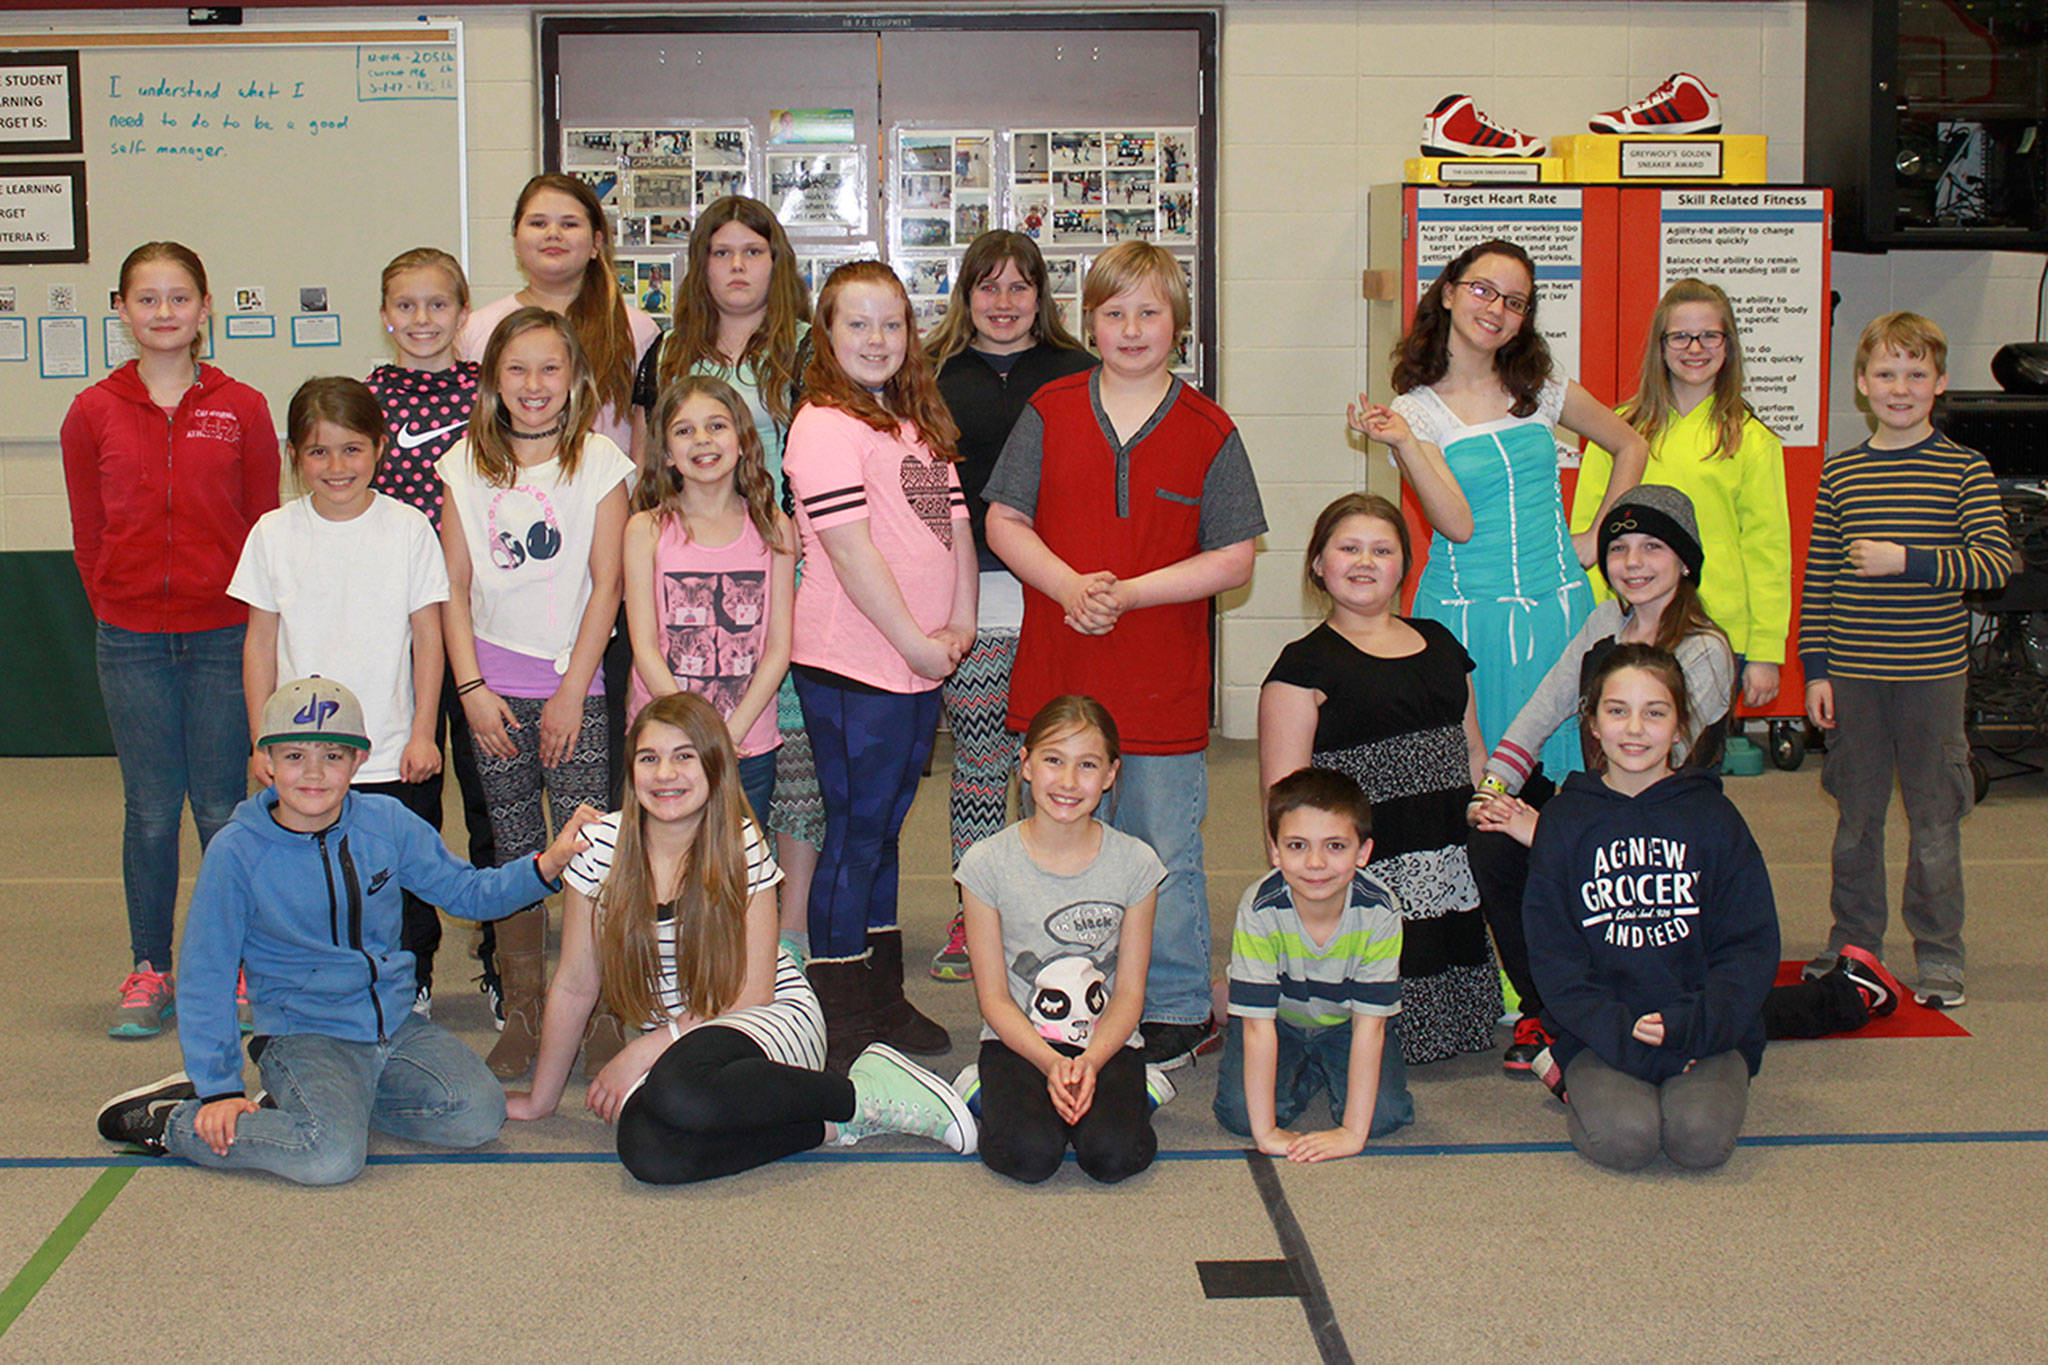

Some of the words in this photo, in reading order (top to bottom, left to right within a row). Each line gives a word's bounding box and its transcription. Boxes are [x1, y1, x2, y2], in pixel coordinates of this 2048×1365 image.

[5, 74, 63, 87] STUDENT
[109, 75, 122, 98] I
[138, 77, 221, 99] understand
[238, 80, 280, 98] what
[292, 82, 304, 98] I
[0, 95, 43, 108] RNING
[32, 116, 48, 129] IS:
[109, 112, 144, 128] need
[161, 112, 177, 127] to
[191, 113, 210, 128] do
[222, 114, 240, 129] to
[254, 115, 274, 130] be
[286, 121, 295, 130] a
[309, 115, 349, 136] good
[110, 139, 146, 155] self
[156, 145, 228, 161] manager.
[1680, 150, 1712, 158] GOLDEN
[6, 183, 63, 194] LEARNING
[1443, 193, 1484, 206] Target
[1489, 193, 1524, 204] Heart
[1528, 193, 1557, 204] Rate
[1678, 194, 1705, 205] Skill
[1710, 194, 1758, 205] Related
[1763, 194, 1807, 206] Fitness
[1458, 224, 1494, 233] slacking
[1497, 224, 1510, 232] off
[1526, 224, 1560, 233] working
[1563, 224, 1578, 232] too
[1718, 227, 1745, 237] ability
[1762, 227, 1795, 236] change
[1515, 234, 1550, 242] estimate
[1555, 235, 1575, 243] your
[1666, 237, 1712, 245] directions
[1715, 237, 1749, 246] quickly
[1429, 244, 1456, 252] target
[1422, 253, 1453, 262] getting
[1722, 256, 1751, 266] ability
[1767, 256, 1799, 265] remain
[1666, 266, 1699, 275] upright
[1702, 266, 1725, 274] while
[1729, 266, 1768, 276] standing
[1771, 266, 1787, 274] still
[1745, 296, 1774, 305] ability
[1784, 306, 1808, 315] body
[1744, 315, 1779, 324] specific
[1770, 356, 1804, 365] quickly
[1750, 375, 1784, 383] amount
[1786, 375, 1797, 383] of
[1755, 385, 1788, 394] moving
[1758, 404, 1795, 413] perform
[1794, 423, 1804, 431] of
[1594, 837, 1687, 879] AGNEW
[1073, 916, 1113, 931] black
[1604, 922, 1645, 949] AND
[1646, 916, 1691, 947] FEED
